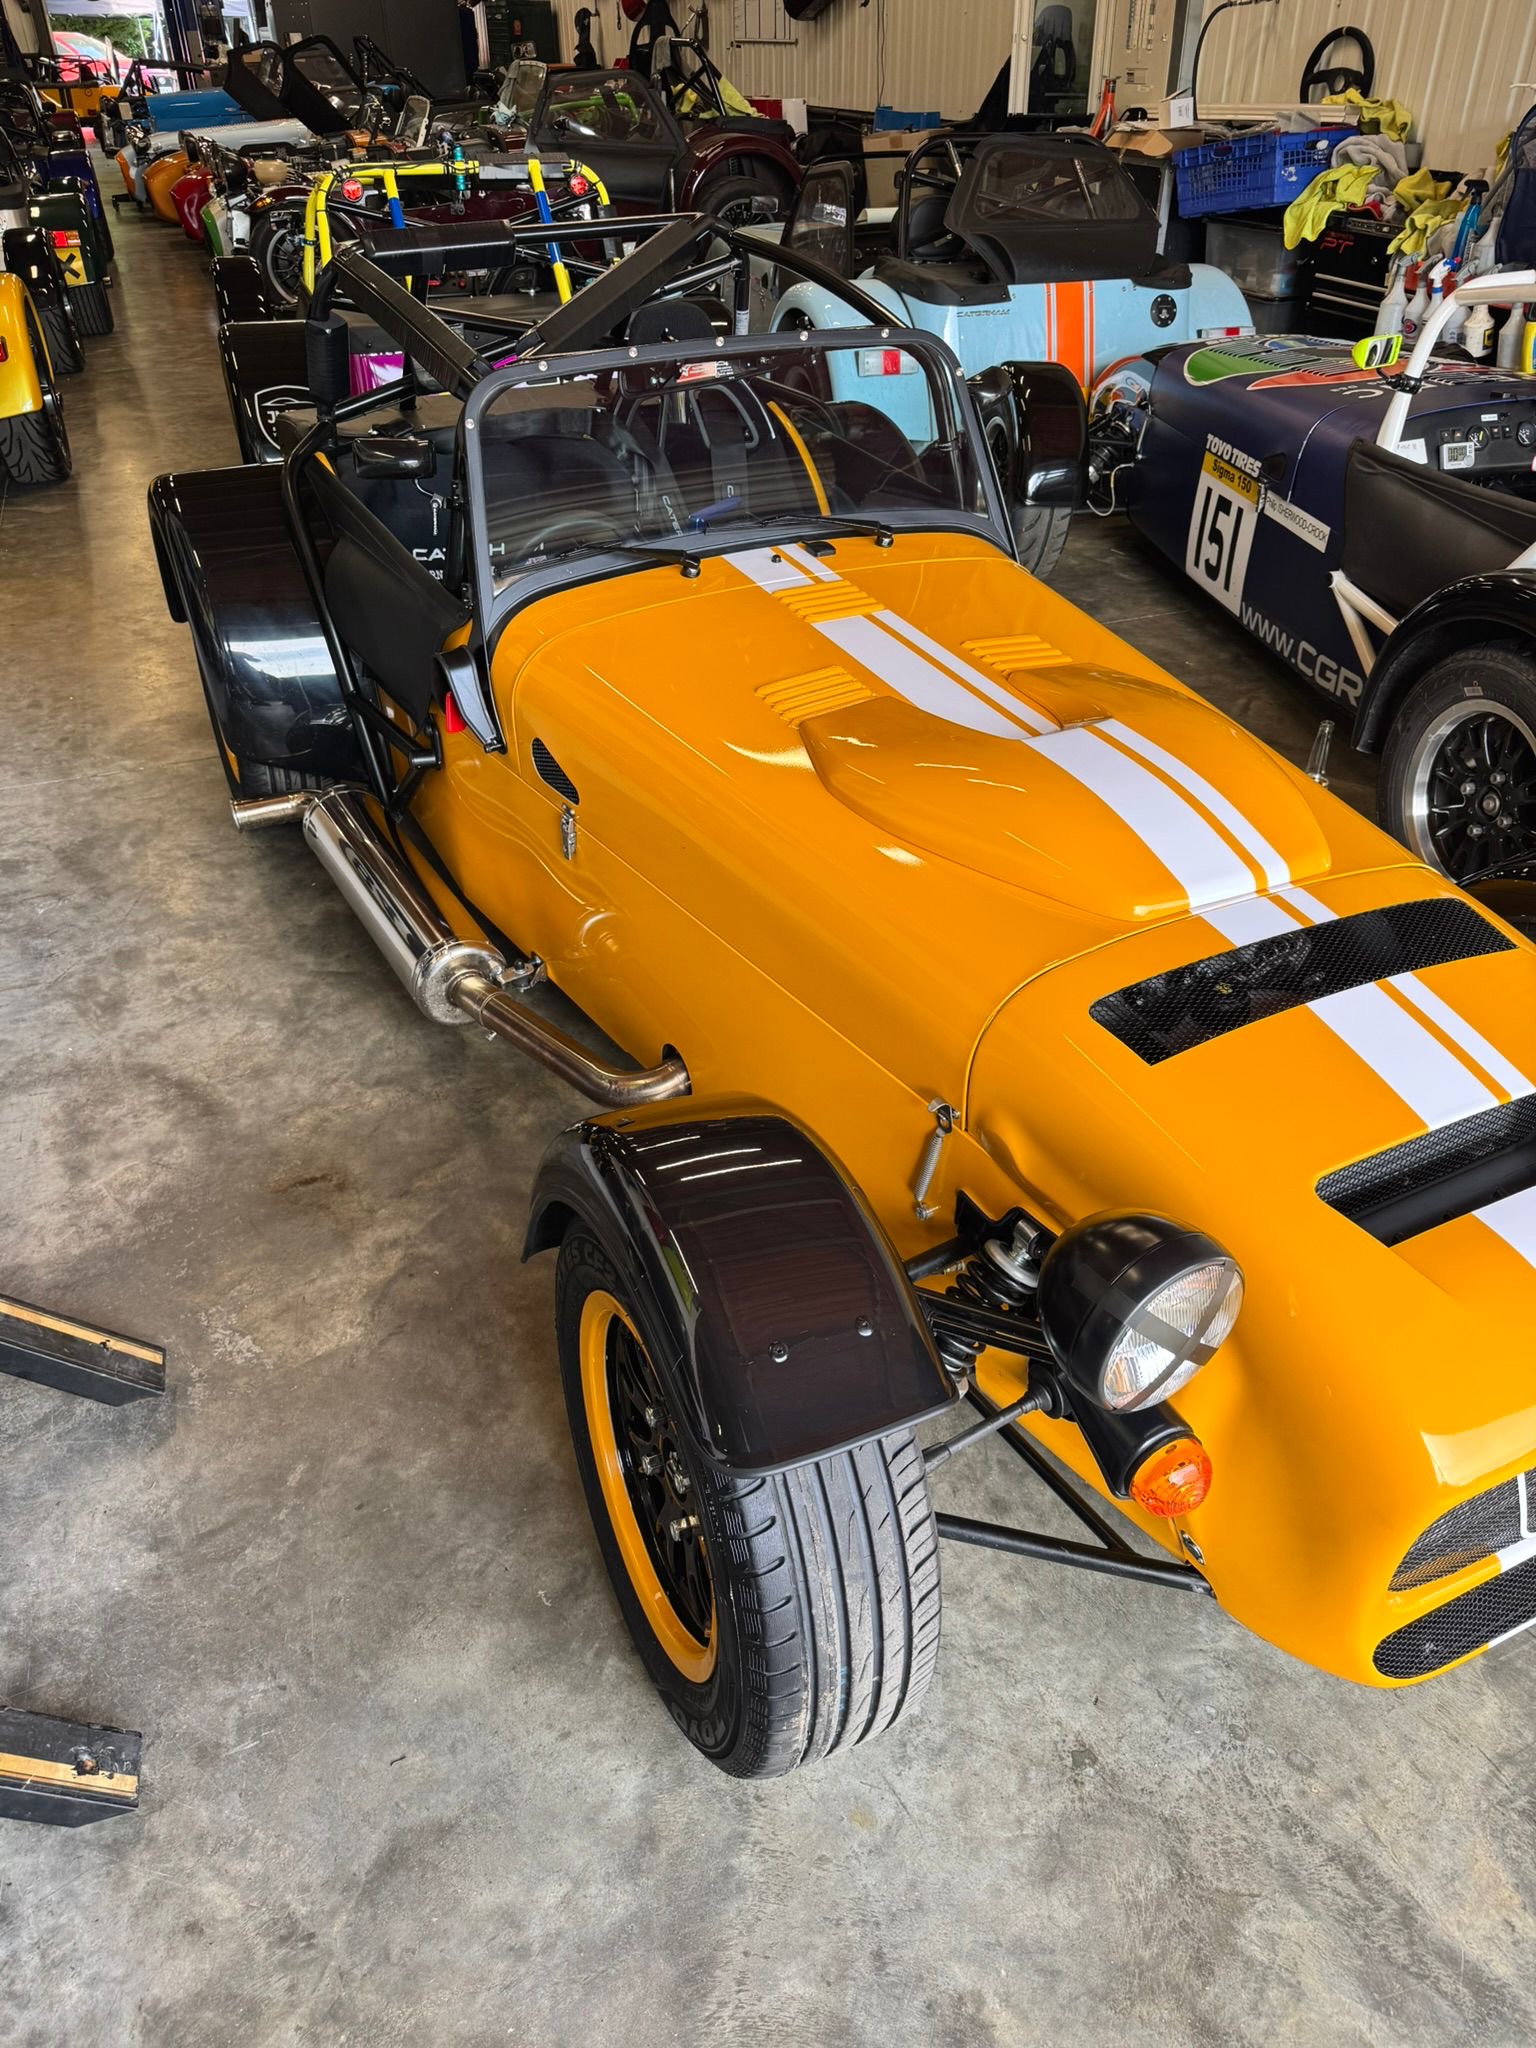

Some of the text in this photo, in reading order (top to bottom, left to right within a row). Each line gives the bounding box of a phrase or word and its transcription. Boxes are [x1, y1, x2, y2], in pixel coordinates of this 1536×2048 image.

[1205, 433, 1262, 478] TOYO TIRES
[1212, 459, 1252, 493] Sigma 150
[1194, 485, 1244, 592] 151
